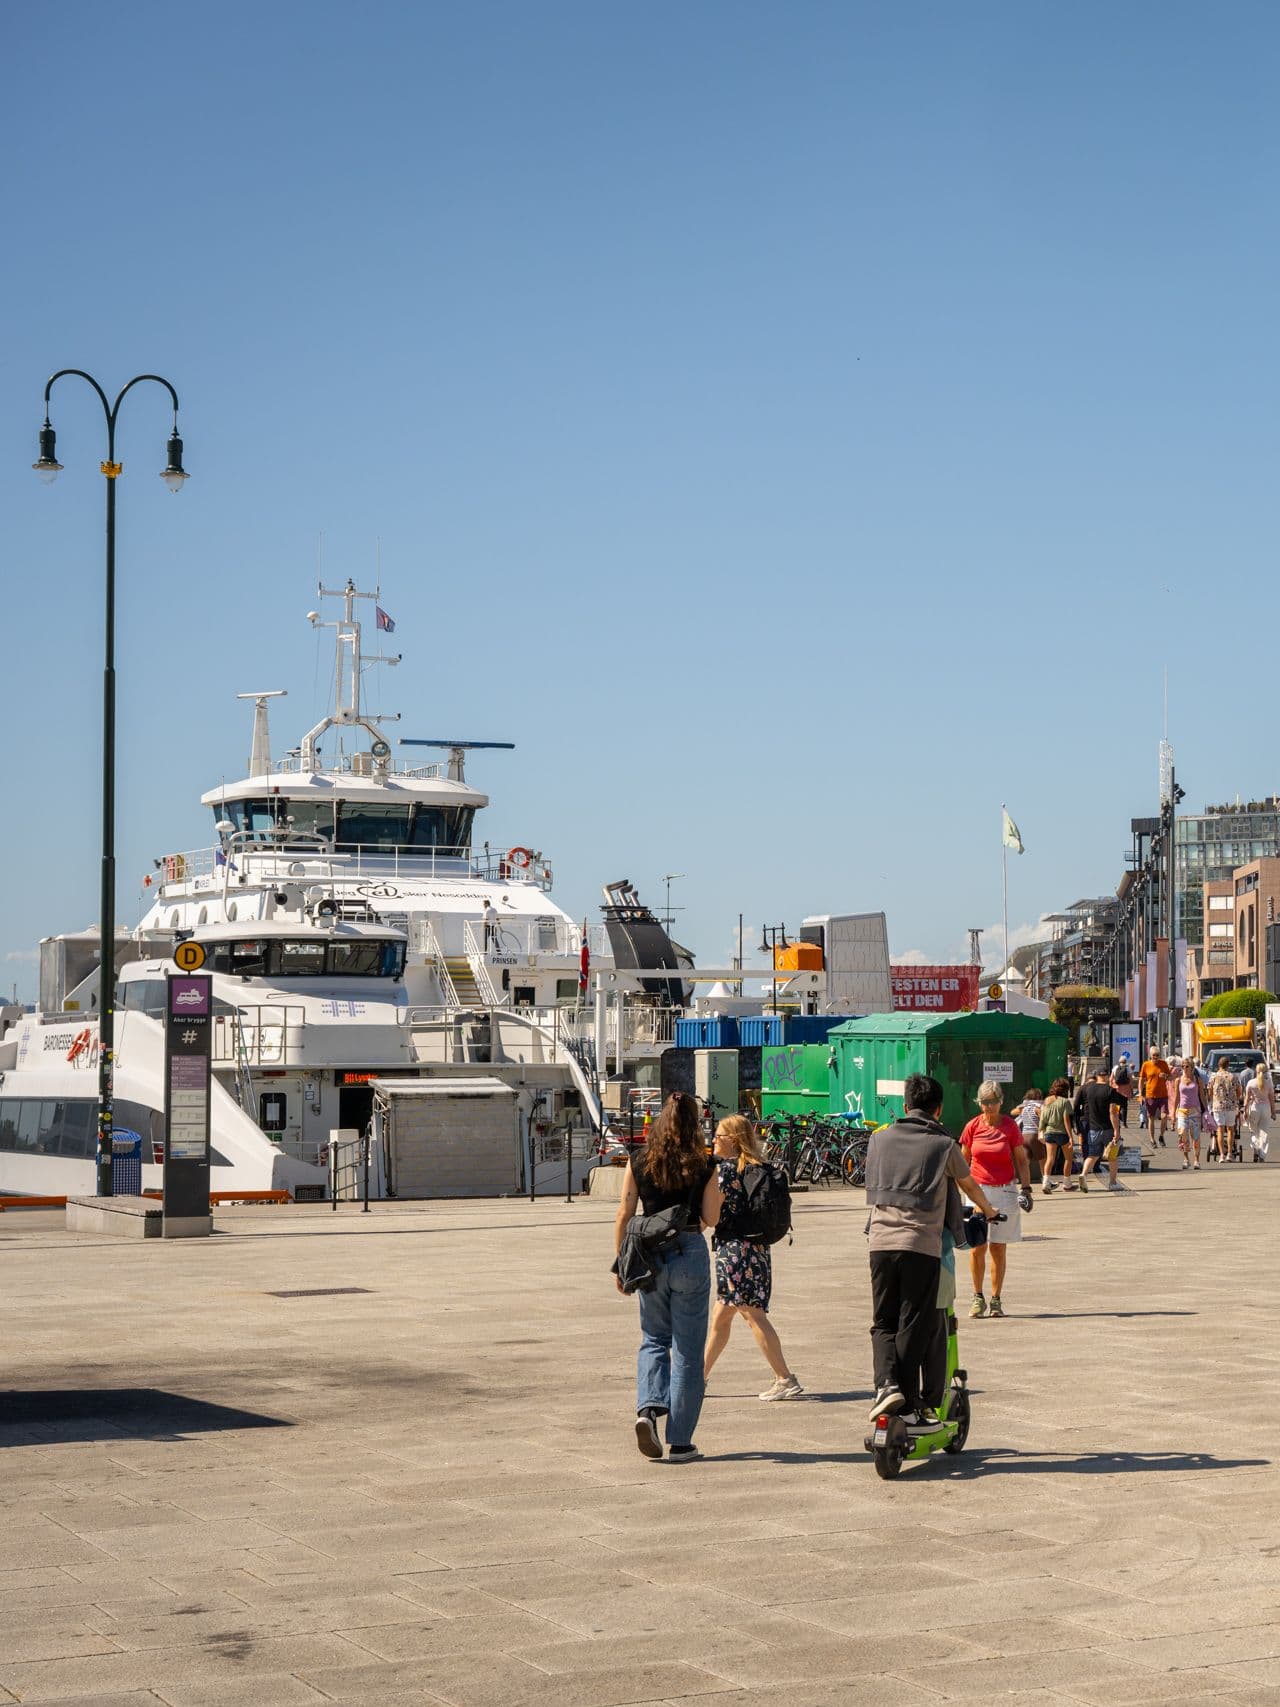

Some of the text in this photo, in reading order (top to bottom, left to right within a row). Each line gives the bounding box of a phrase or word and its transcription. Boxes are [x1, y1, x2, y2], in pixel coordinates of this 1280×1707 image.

[184, 948, 197, 965] D
[492, 957, 518, 965] PRINSEN
[941, 978, 959, 991] ER
[893, 994, 943, 1007] ELT DEN
